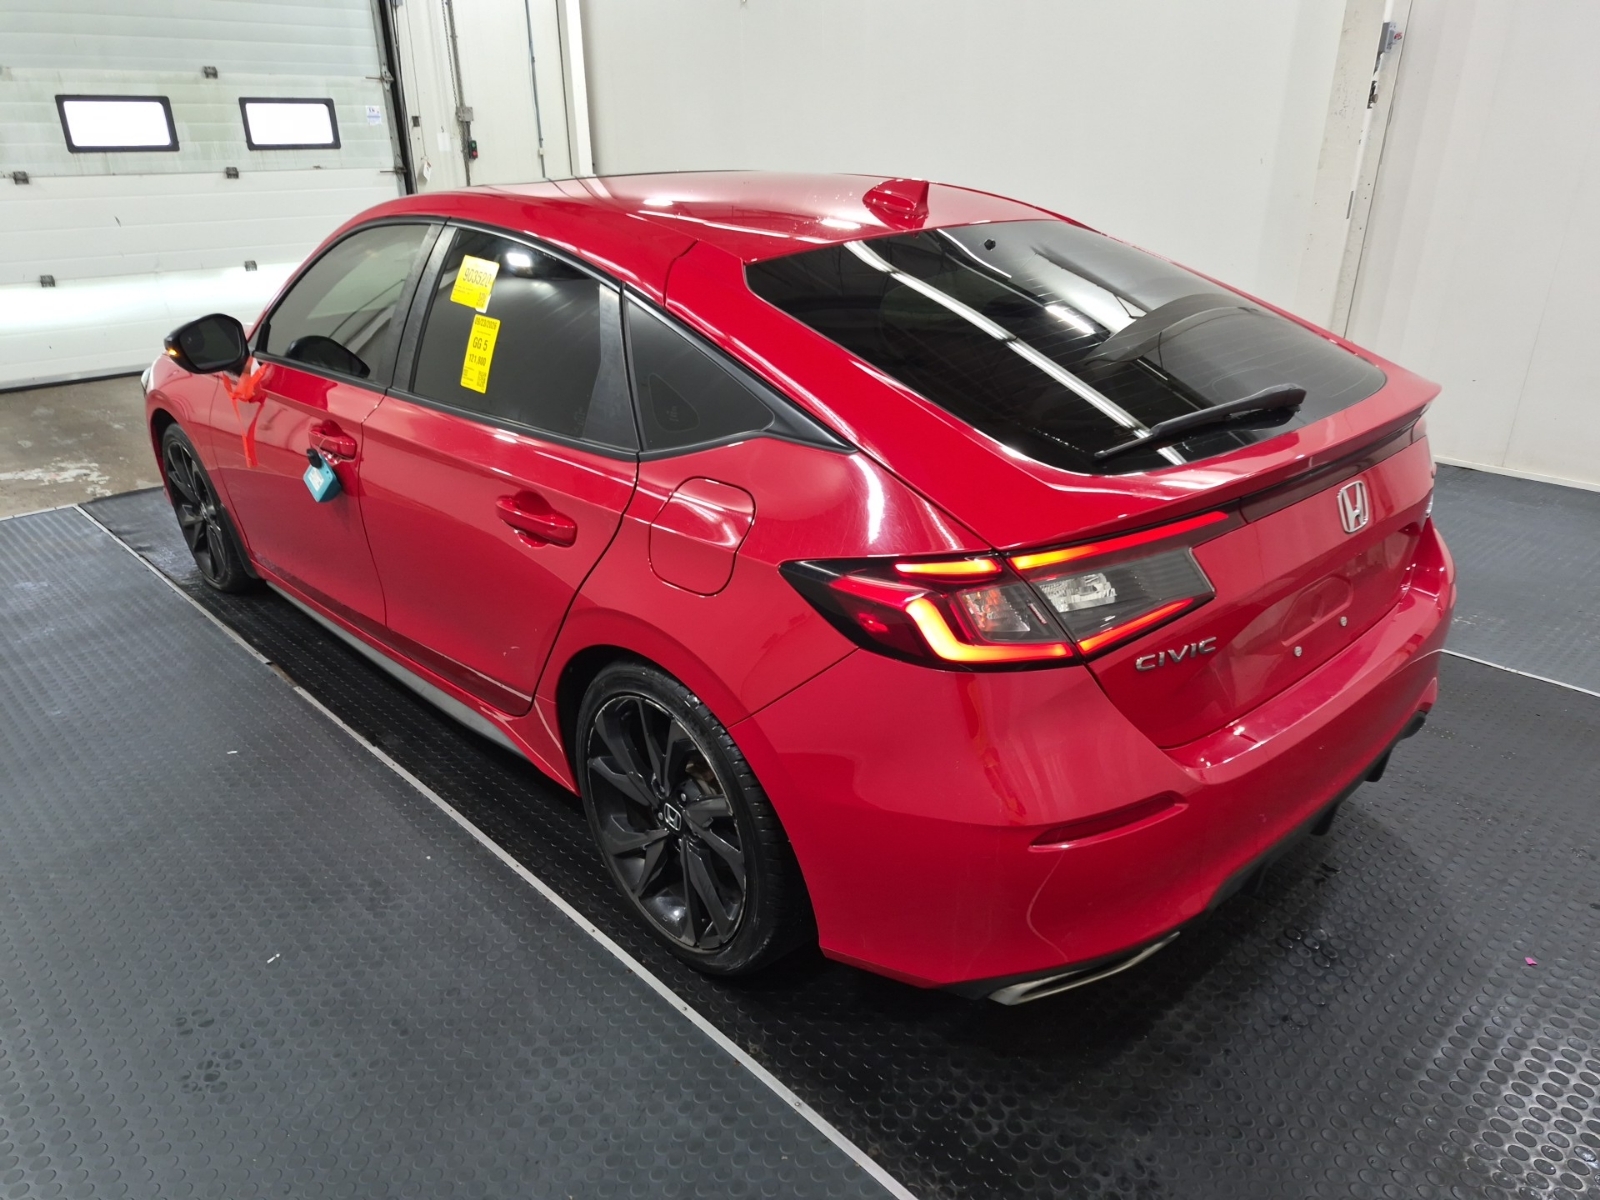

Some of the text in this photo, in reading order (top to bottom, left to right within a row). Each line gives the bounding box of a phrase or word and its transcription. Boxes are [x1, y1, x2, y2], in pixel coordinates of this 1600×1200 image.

[462, 267, 492, 288] 903520
[472, 336, 488, 352] GG 5
[1136, 637, 1217, 672] CIVIC
